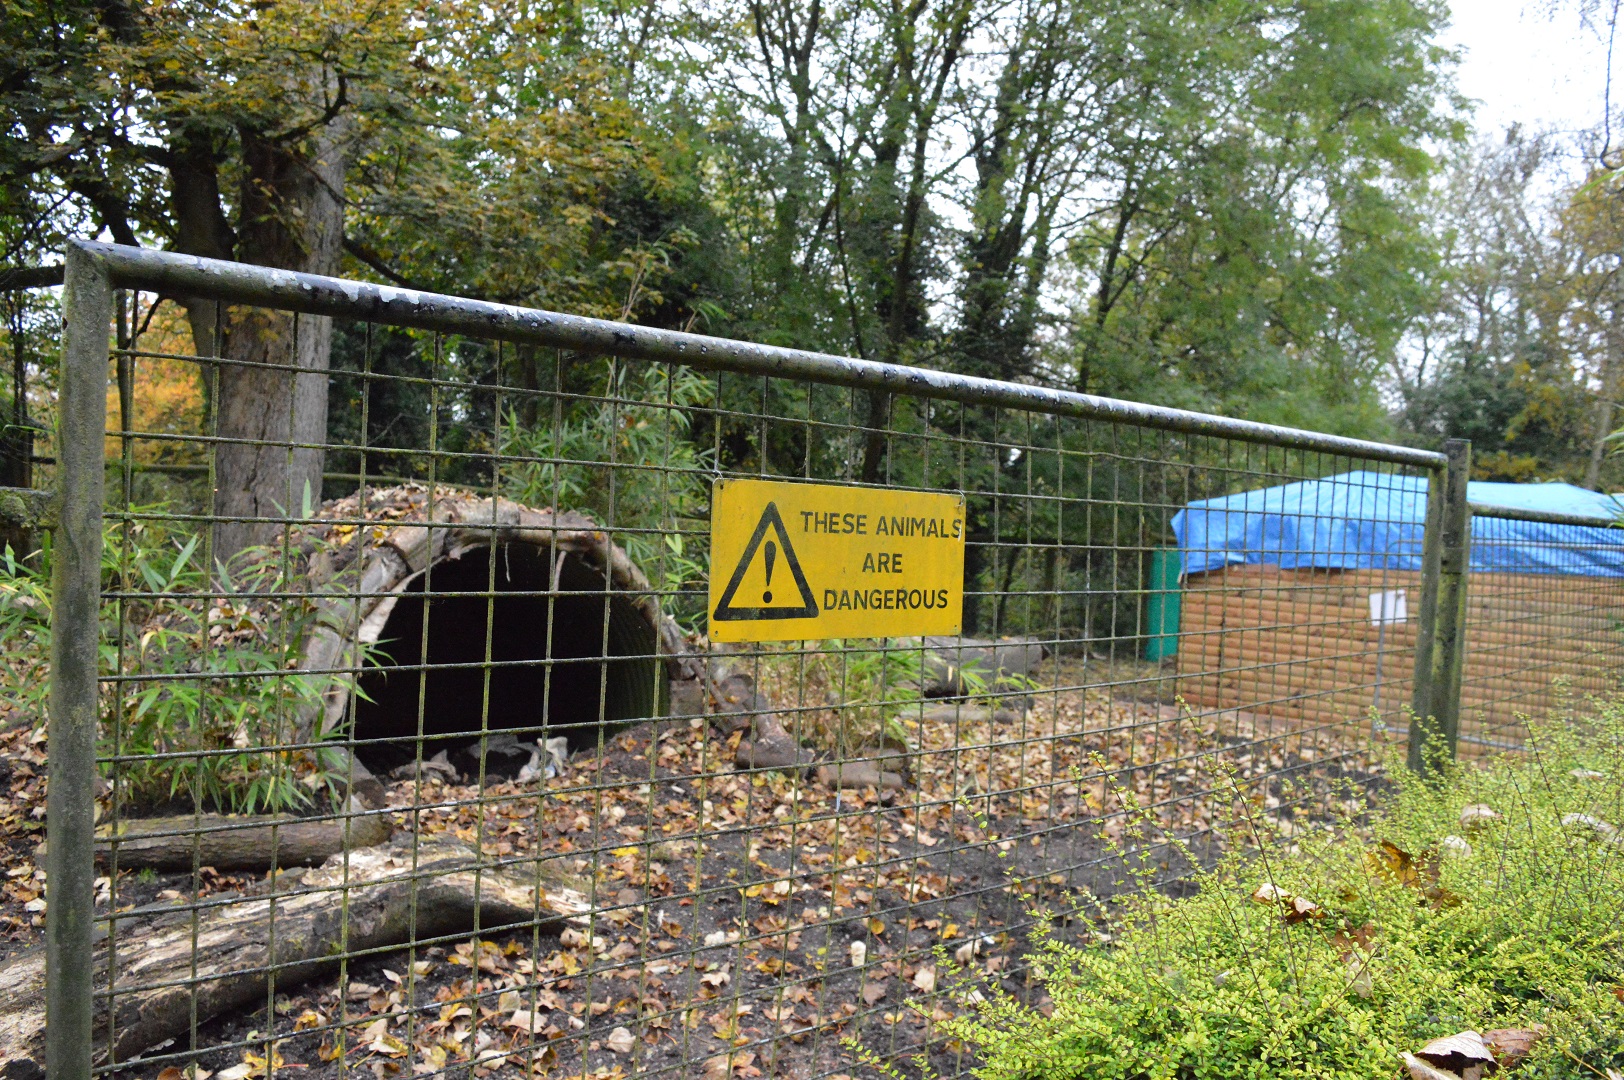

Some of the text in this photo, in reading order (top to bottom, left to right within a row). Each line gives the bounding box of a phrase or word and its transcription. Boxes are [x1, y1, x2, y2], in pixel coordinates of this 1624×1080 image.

[800, 511, 963, 538] THESE ANIMALS
[862, 552, 903, 573] ARE
[824, 589, 948, 610] DANGEROUS
